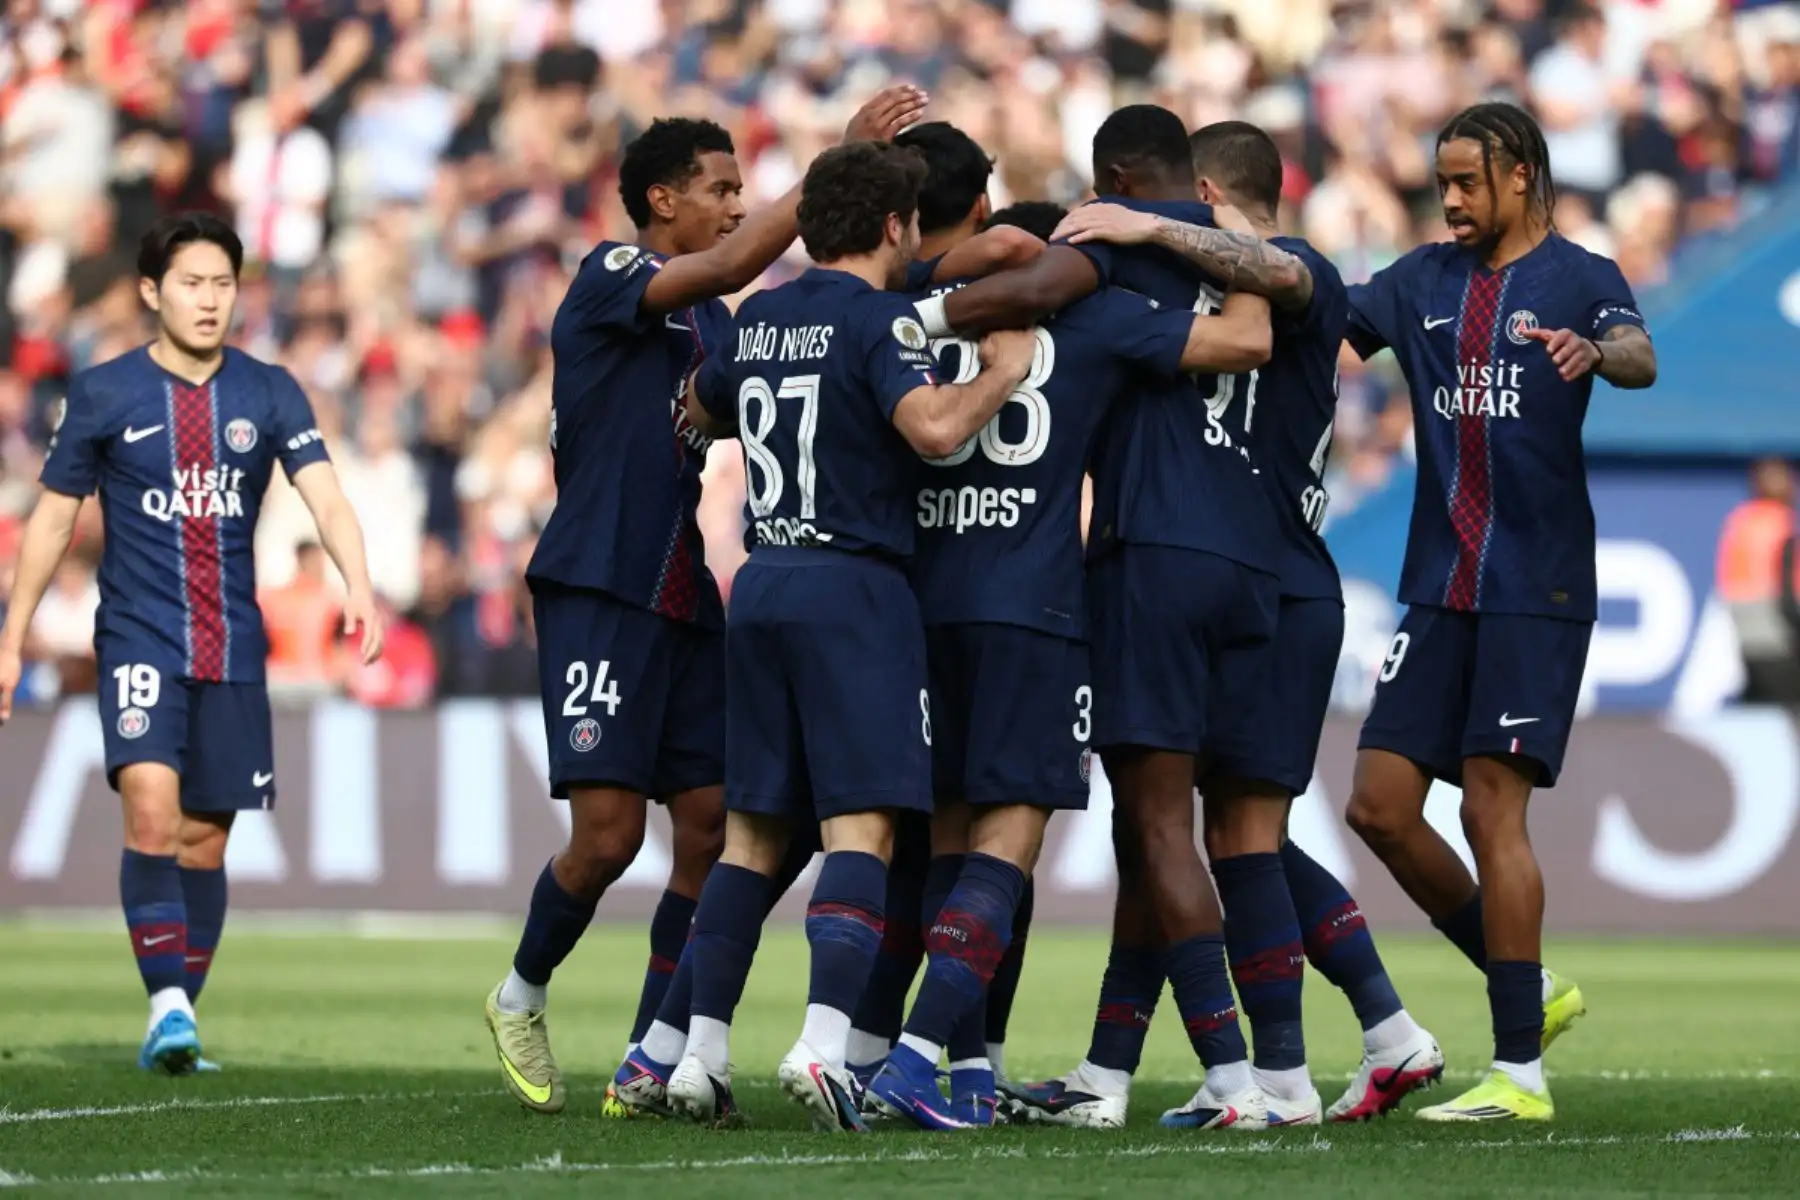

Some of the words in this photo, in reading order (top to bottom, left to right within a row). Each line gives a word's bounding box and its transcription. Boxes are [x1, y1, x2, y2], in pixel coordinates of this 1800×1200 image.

[734, 321, 777, 362] JOÃO
[779, 324, 834, 362] NEVES
[1456, 357, 1525, 388] visit
[1433, 386, 1521, 420] QATAR
[739, 374, 821, 519] 87
[172, 463, 246, 493] visit
[142, 488, 244, 522] QATAR
[112, 663, 161, 709] 19
[562, 660, 622, 716] 24
[1072, 685, 1093, 742] 3
